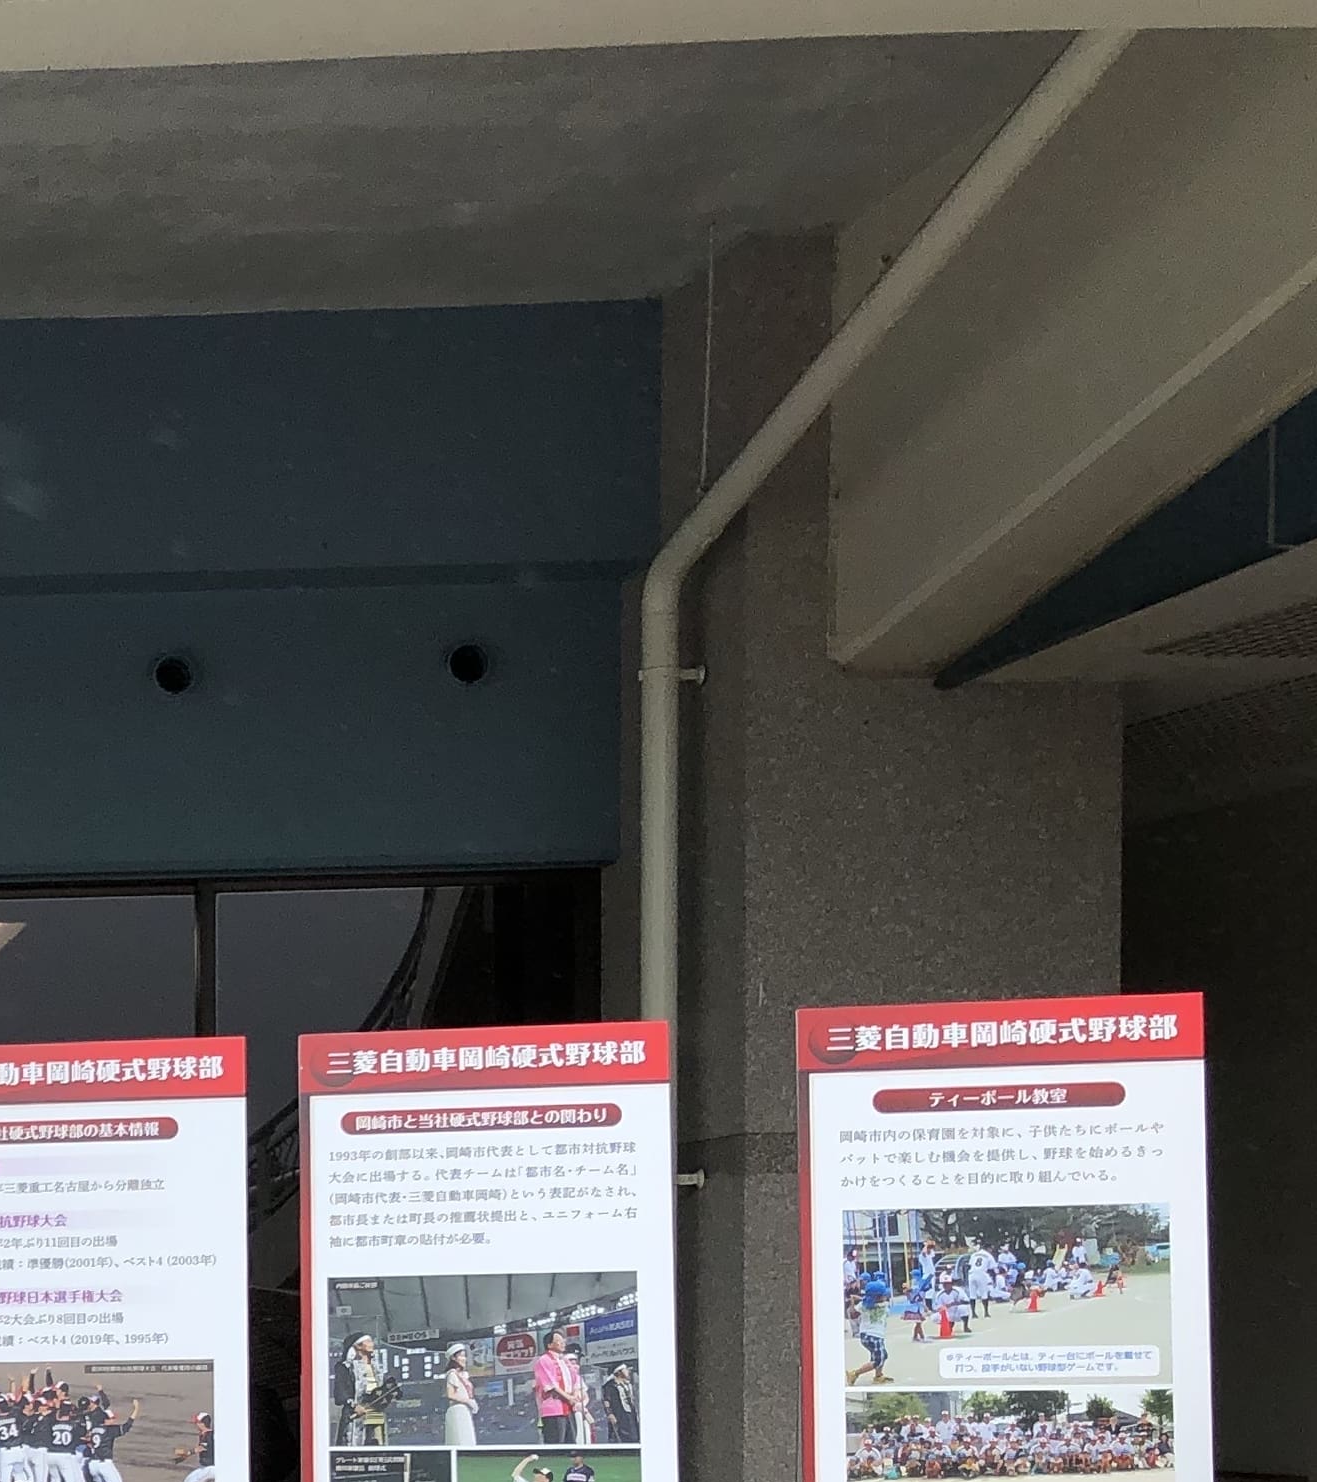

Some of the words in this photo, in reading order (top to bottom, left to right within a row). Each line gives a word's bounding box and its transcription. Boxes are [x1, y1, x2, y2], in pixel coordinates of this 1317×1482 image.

[826, 1013, 1178, 1051] 三菱自動車岡崎硬式野球部
[326, 1039, 646, 1076] 三菱自動車岡崎硬式野球部
[928, 1087, 1068, 1108] ティーボール教室
[355, 1109, 608, 1132] 岡崎市と当社硬式野球部との関わり
[839, 1122, 1164, 1145] 岡崎市内の保育園を対象に、子供たちにボールや
[328, 1141, 636, 1163] 1993年の創部以来、岡崎市代表として都市対抗野球
[839, 1145, 1163, 1166] バットで楽しむ機会を提供し、野球を始めるきっ
[840, 1168, 1118, 1188] かけをつくることを目的に取り組んでいる。
[52, 1431, 72, 1445] 20
